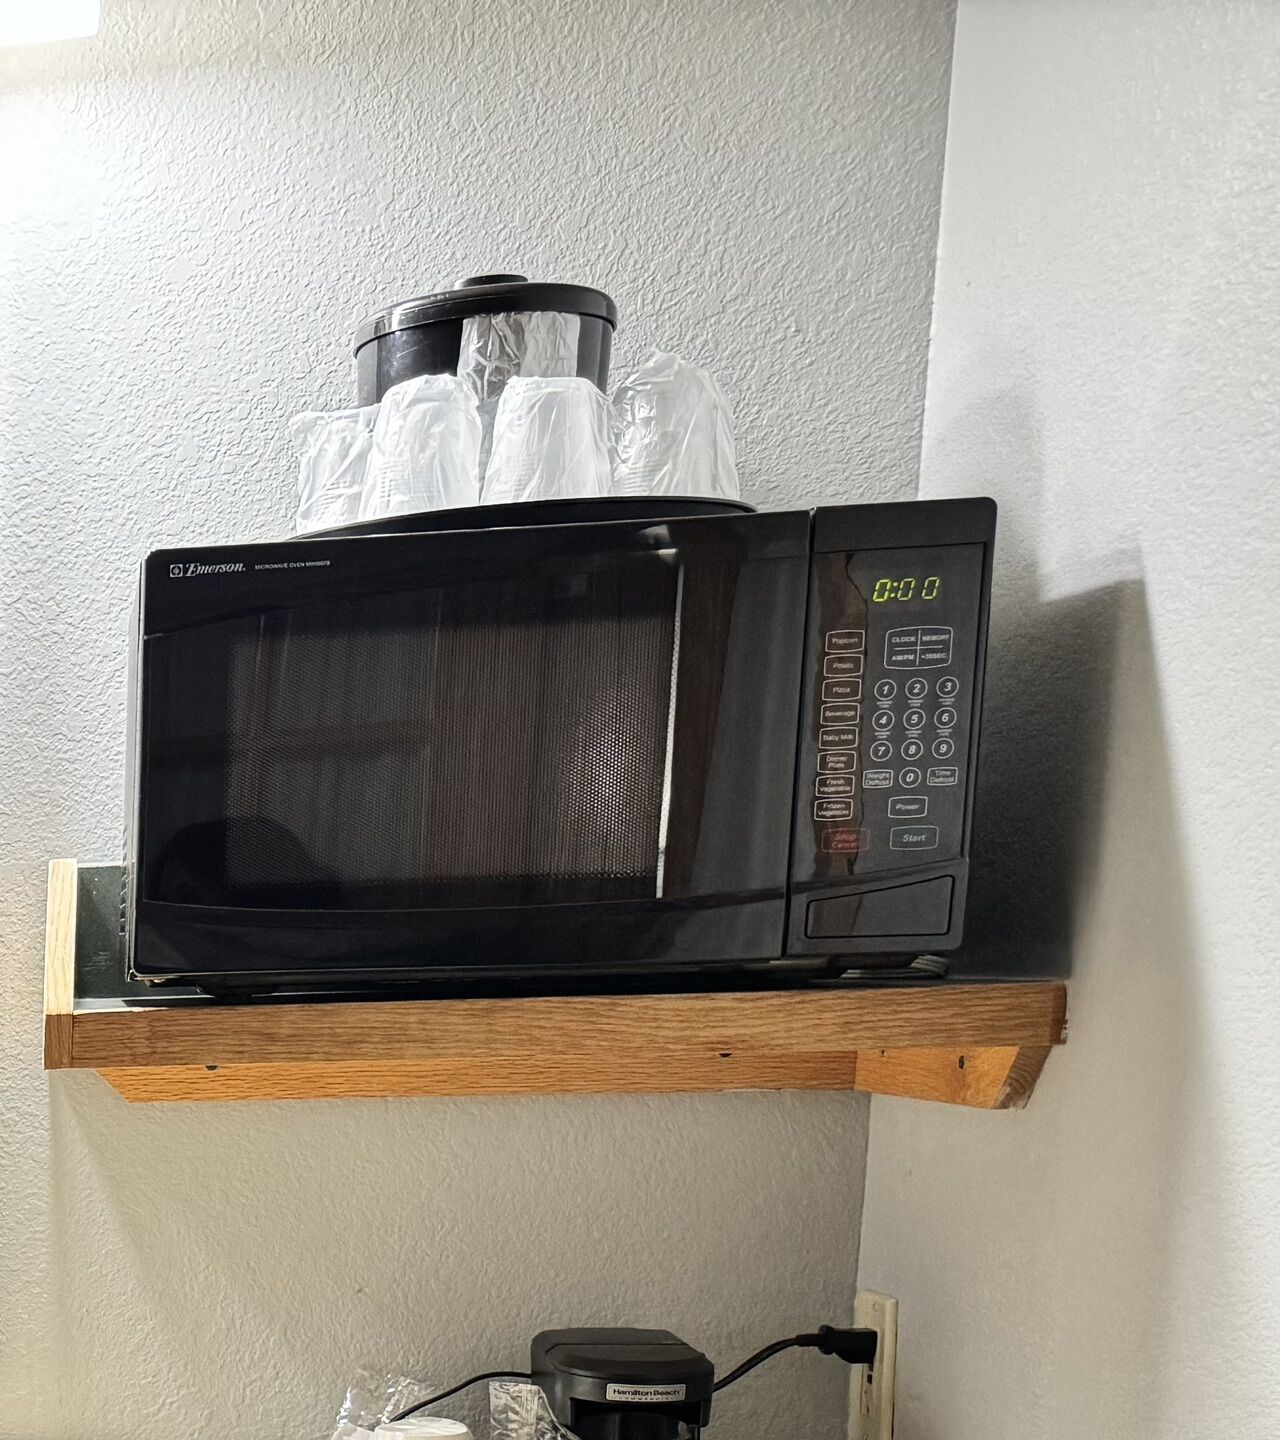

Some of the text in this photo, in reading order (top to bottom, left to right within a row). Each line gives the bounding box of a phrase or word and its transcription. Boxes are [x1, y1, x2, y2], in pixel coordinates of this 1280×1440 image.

[872, 577, 940, 602] 0:00
[881, 685, 889, 695] 1
[913, 684, 921, 693] 2
[944, 682, 952, 692] 3
[878, 715, 887, 725] 4
[910, 714, 919, 724] 5
[941, 712, 950, 722] 6
[878, 746, 886, 756] 7
[908, 745, 916, 754] 8
[939, 744, 948, 753] 9
[906, 773, 914, 782] 0
[902, 834, 926, 842] Start
[613, 1388, 680, 1397] Hamilton Beach
